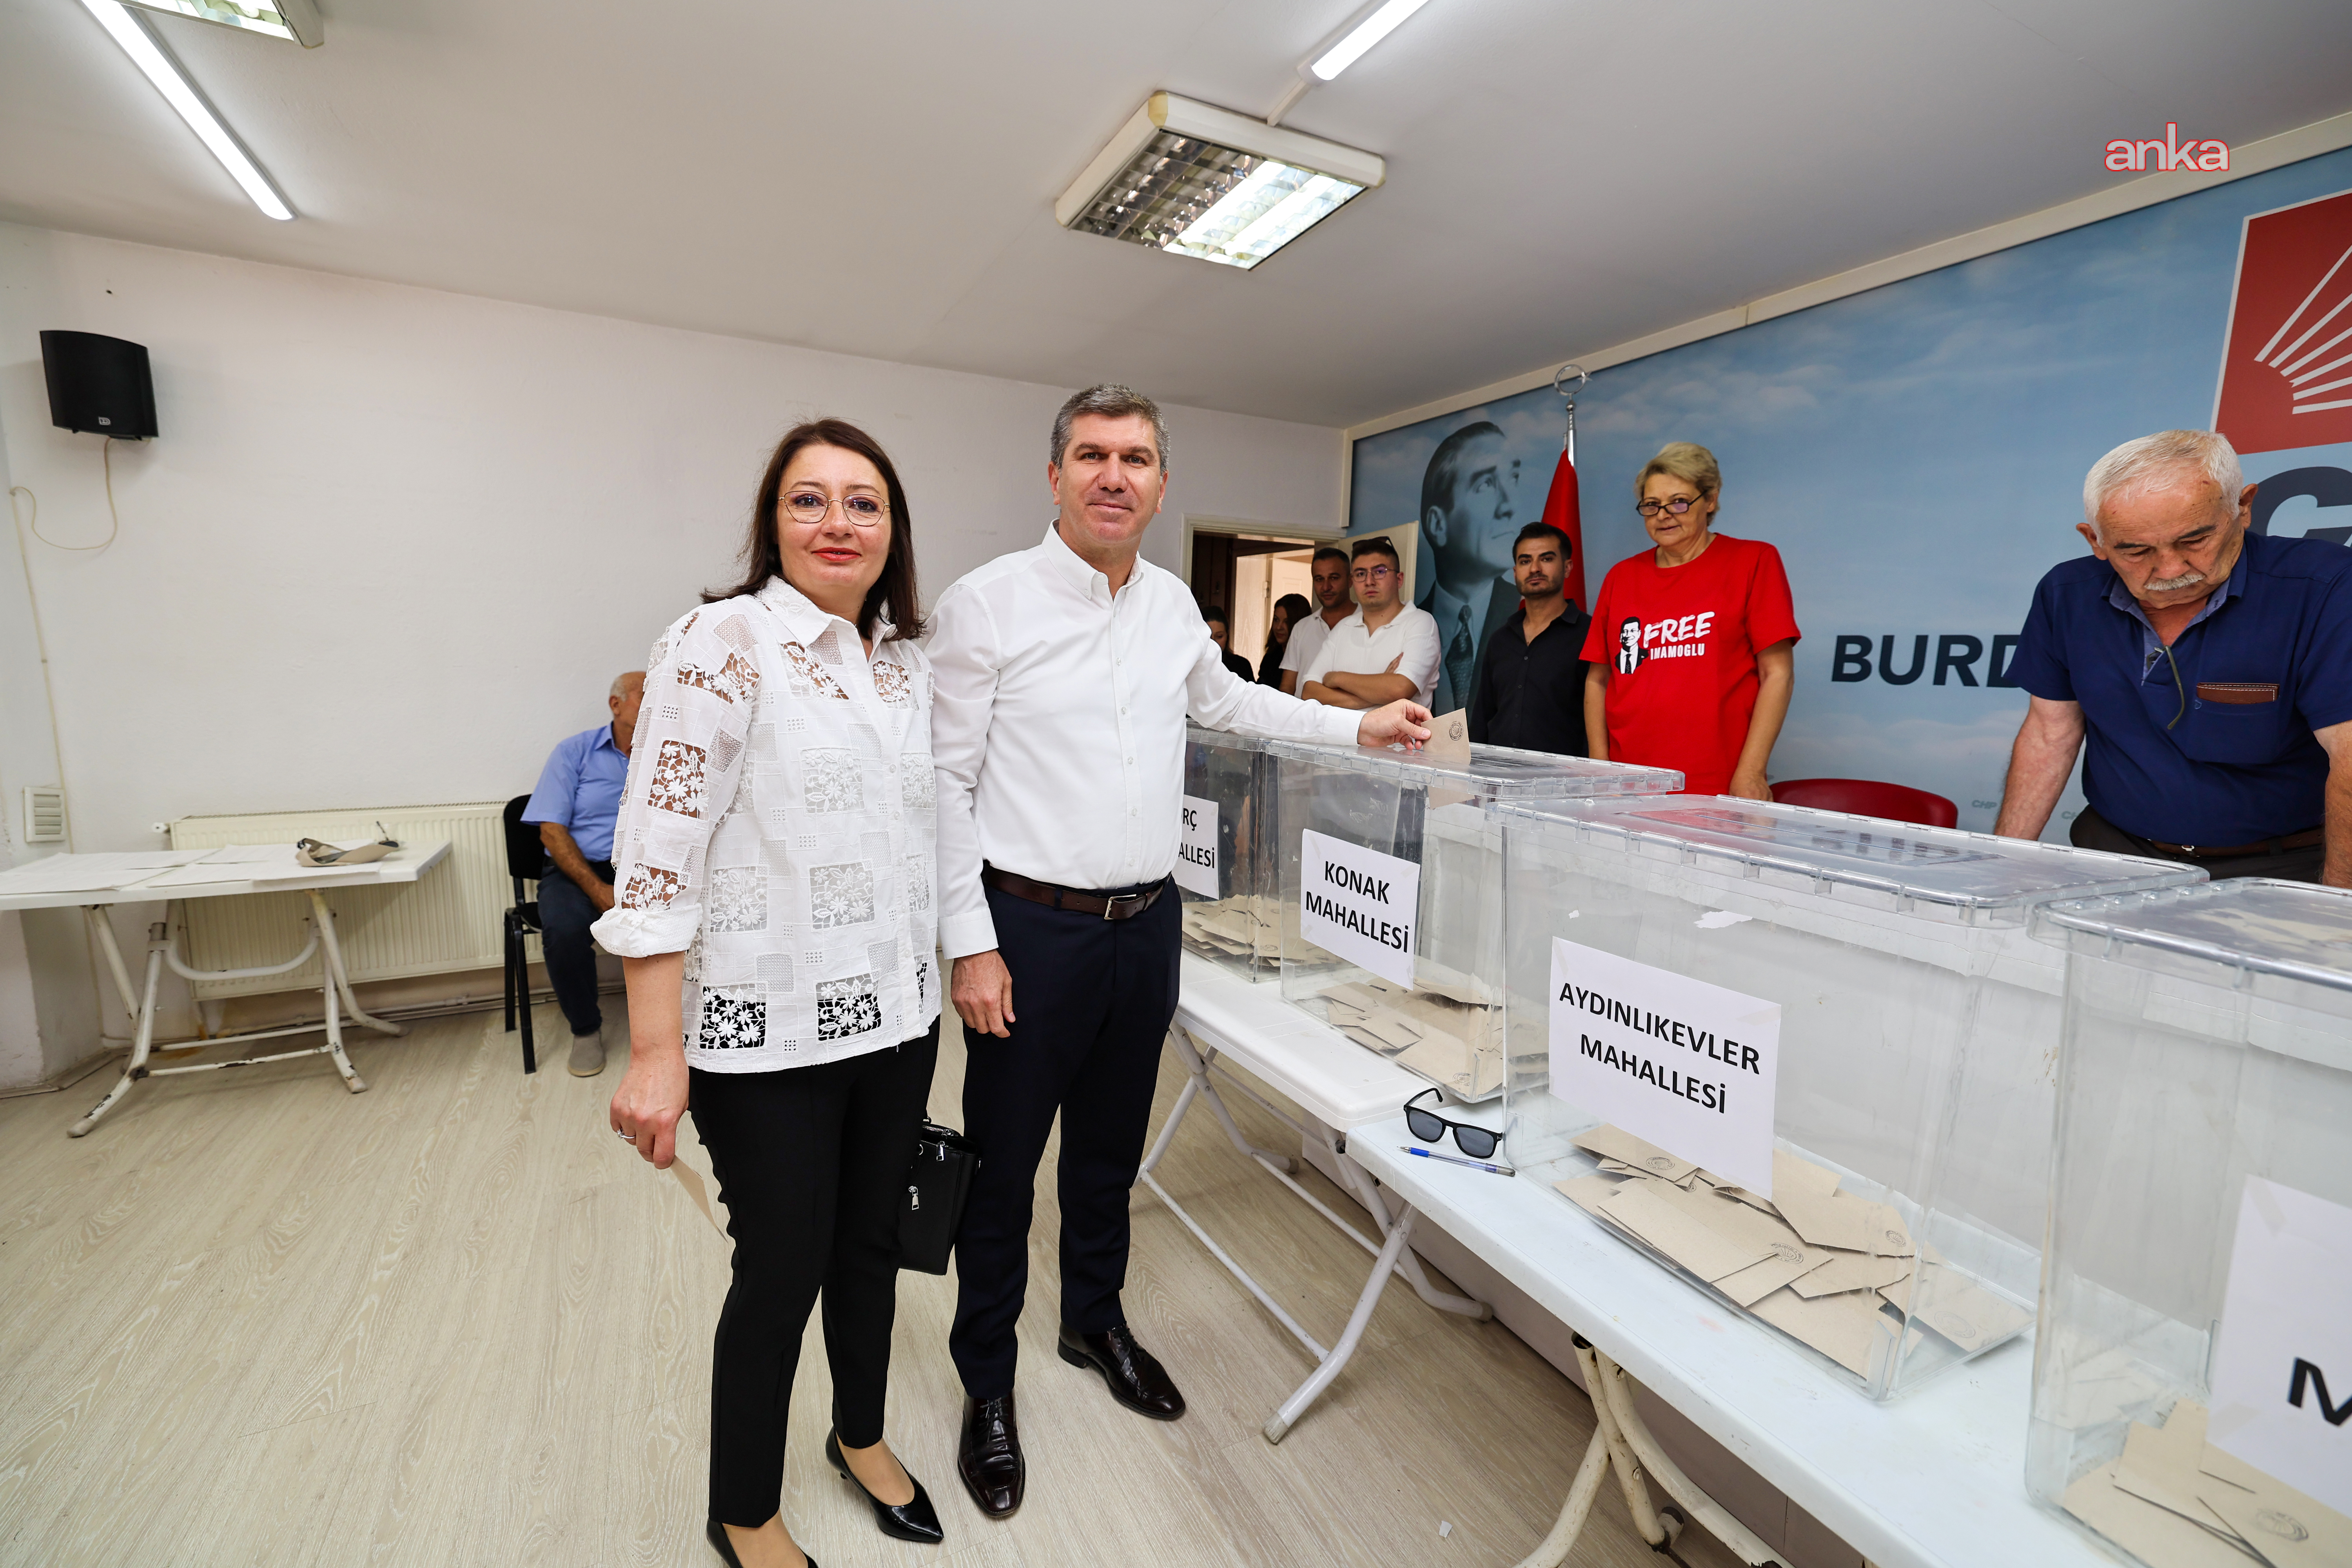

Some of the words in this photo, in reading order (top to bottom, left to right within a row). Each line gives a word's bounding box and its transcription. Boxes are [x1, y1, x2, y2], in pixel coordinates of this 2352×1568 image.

[1643, 611, 1715, 648] FREE
[1650, 643, 1705, 660] IMAMOGLU
[1183, 808, 1197, 831] RÇ
[1178, 842, 1214, 869] ALLESİ
[1325, 861, 1390, 905] KONAK
[1306, 891, 1408, 953] MAHALLESİ
[1559, 983, 1760, 1075] AYDINLIKEVLER
[1581, 1034, 1726, 1114] MAHALLESİ
